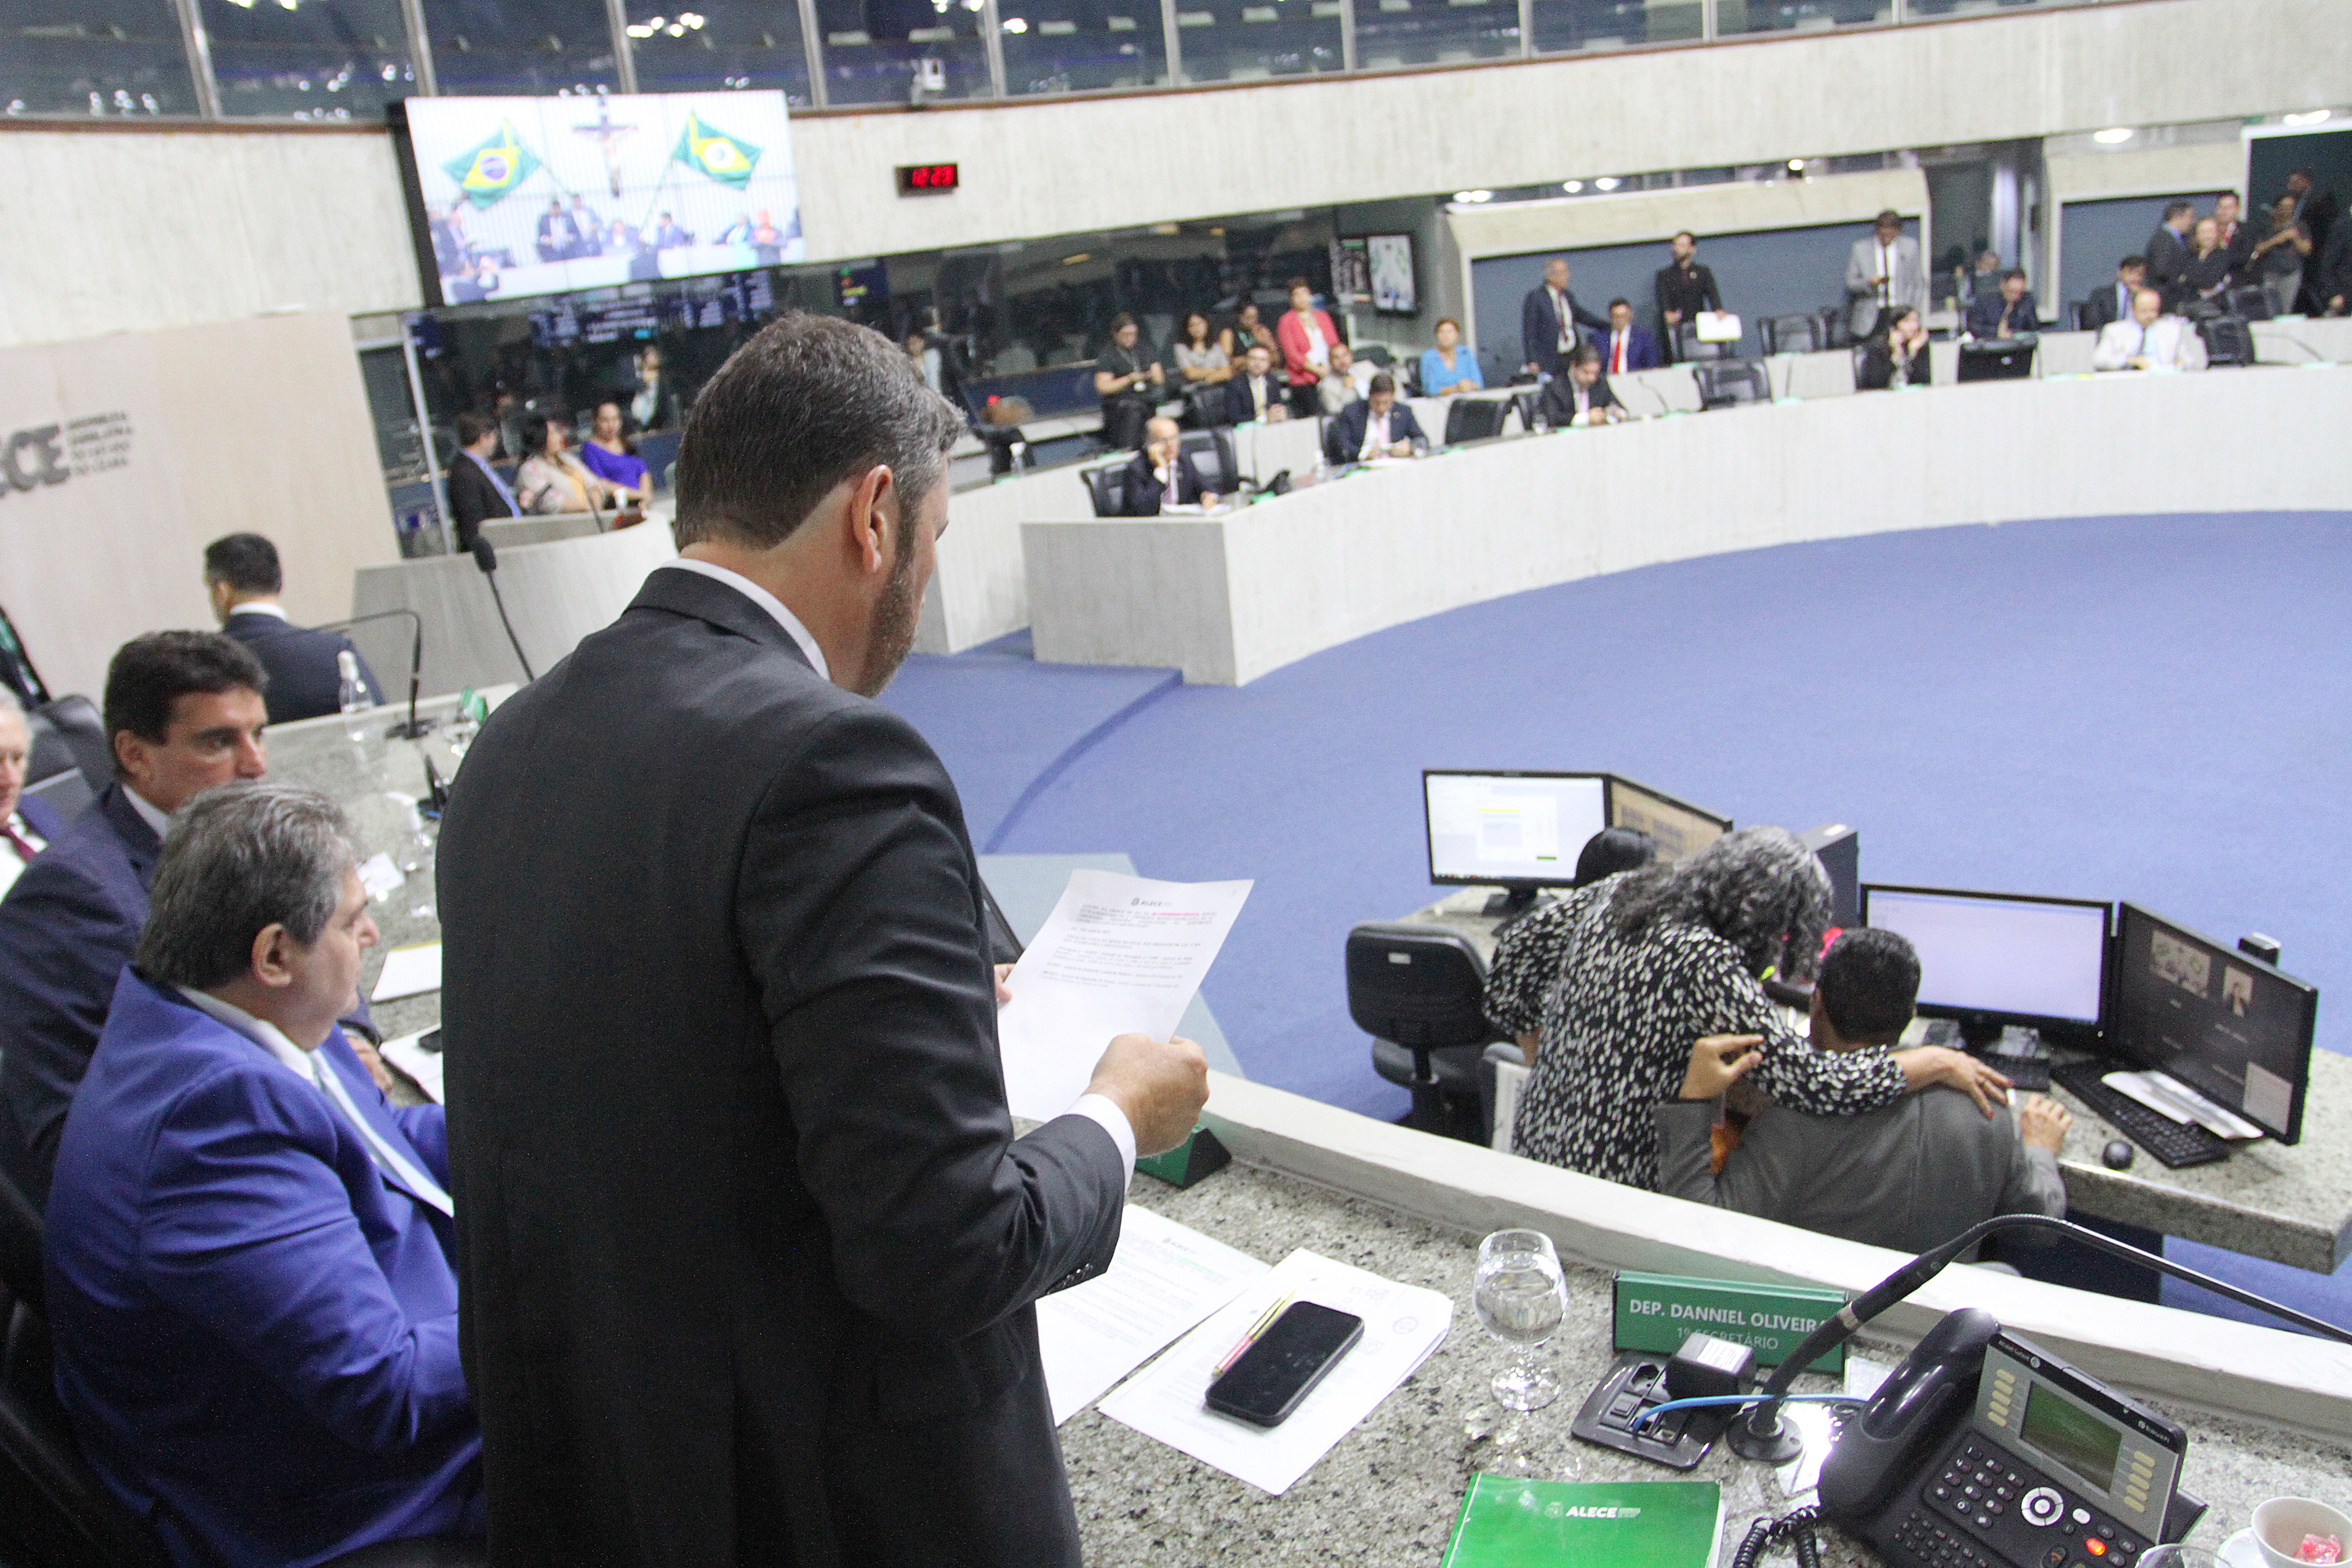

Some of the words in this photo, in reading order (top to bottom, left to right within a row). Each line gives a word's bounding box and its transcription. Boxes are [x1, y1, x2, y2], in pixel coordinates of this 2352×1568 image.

[1630, 1299, 1665, 1316] DEP.
[1670, 1303, 1746, 1326] DANNIEL
[1750, 1313, 1827, 1333] OLIVEIR
[1566, 1506, 1617, 1518] ALECE
